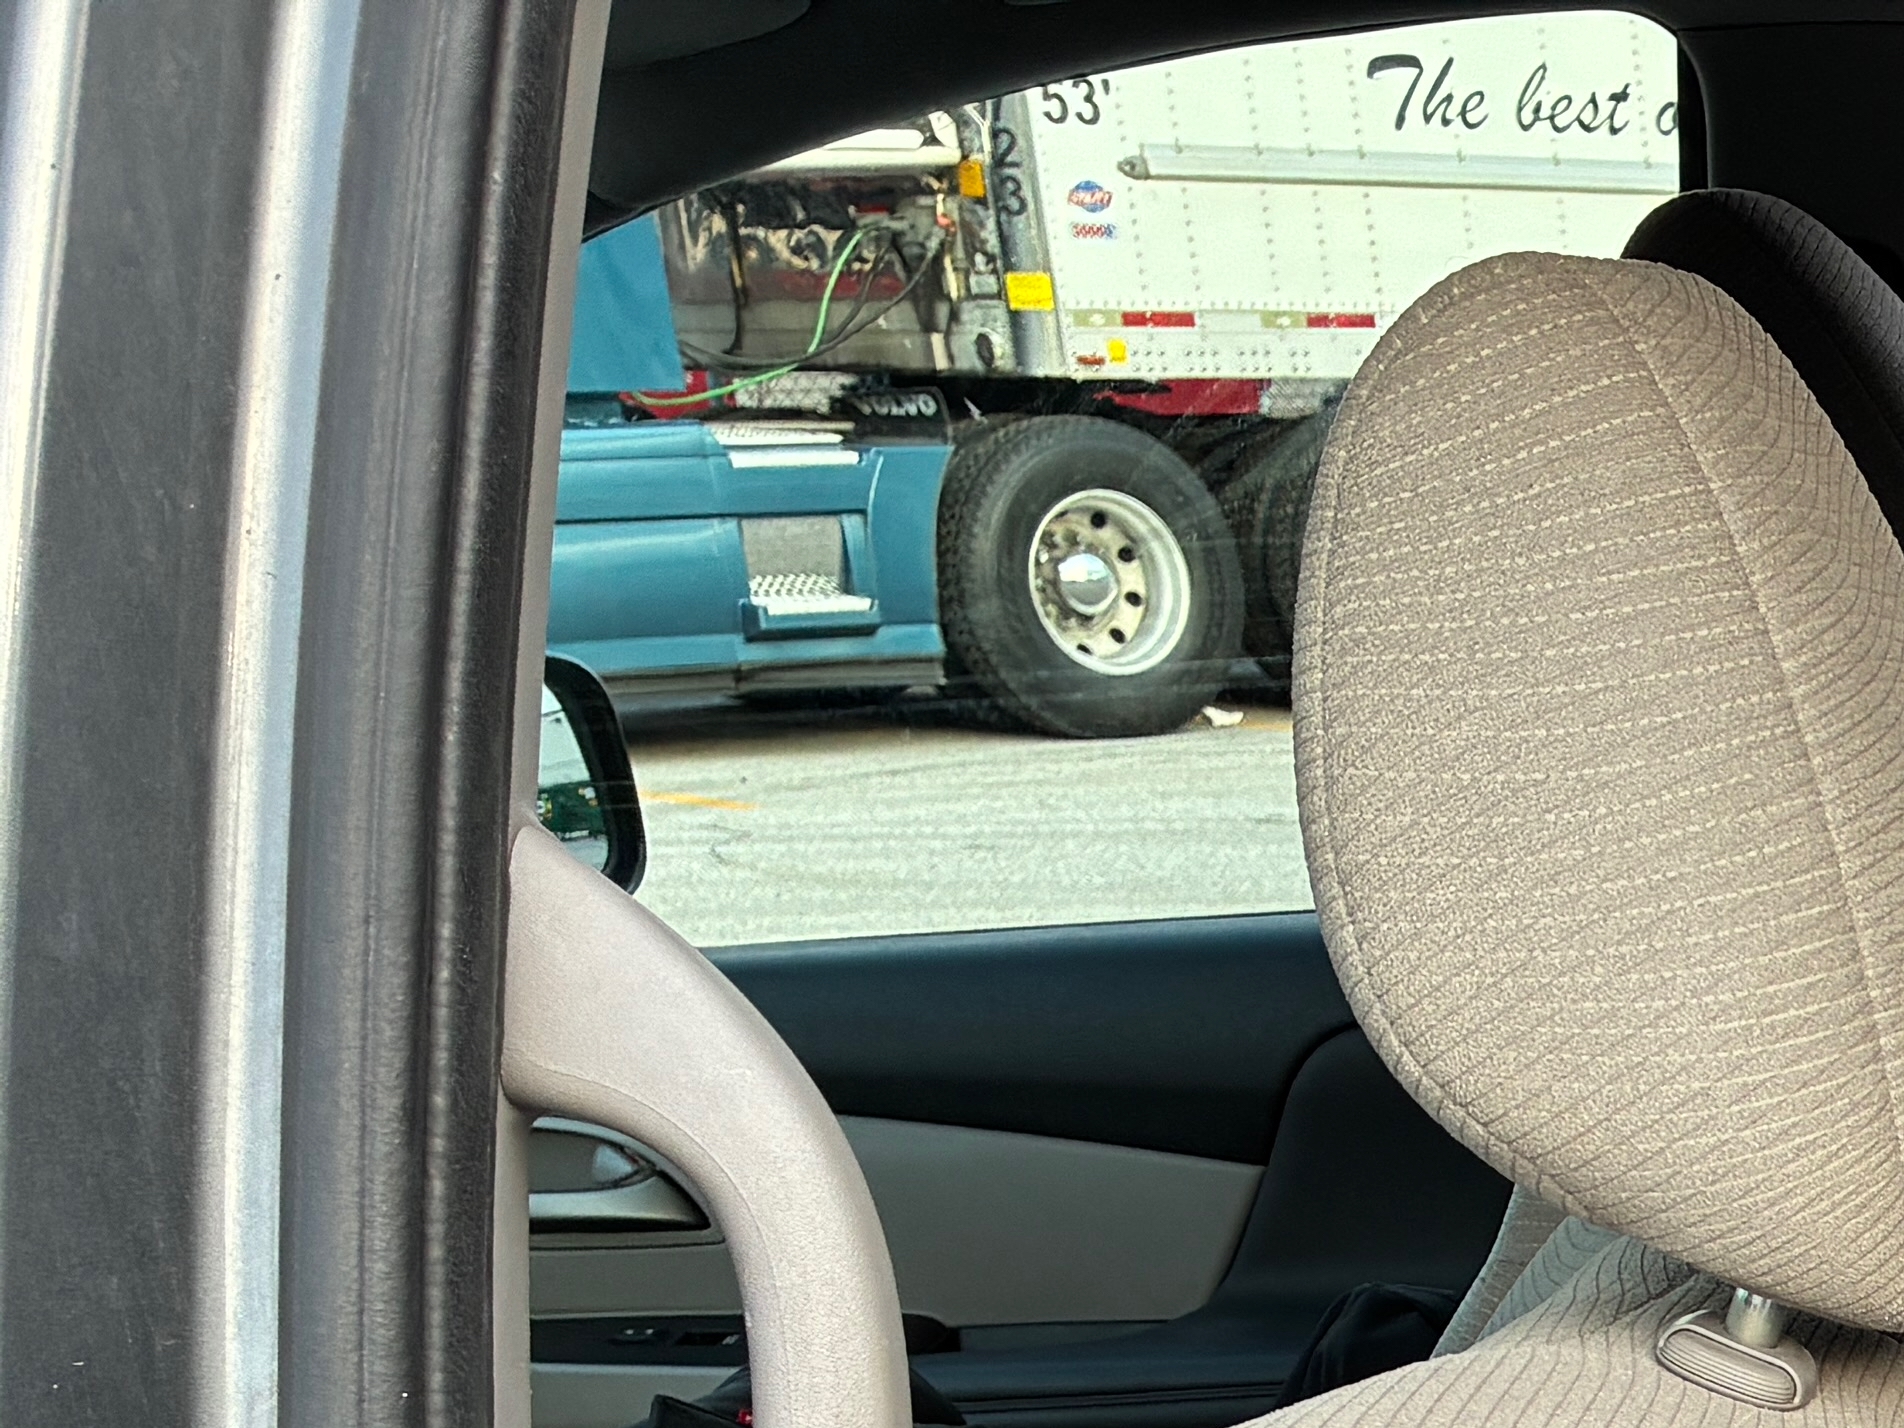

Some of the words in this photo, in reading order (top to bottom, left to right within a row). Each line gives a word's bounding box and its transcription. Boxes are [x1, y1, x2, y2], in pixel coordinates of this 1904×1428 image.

[1042, 78, 1111, 126] 53'
[1366, 53, 1489, 131] The
[1516, 61, 1632, 135] best
